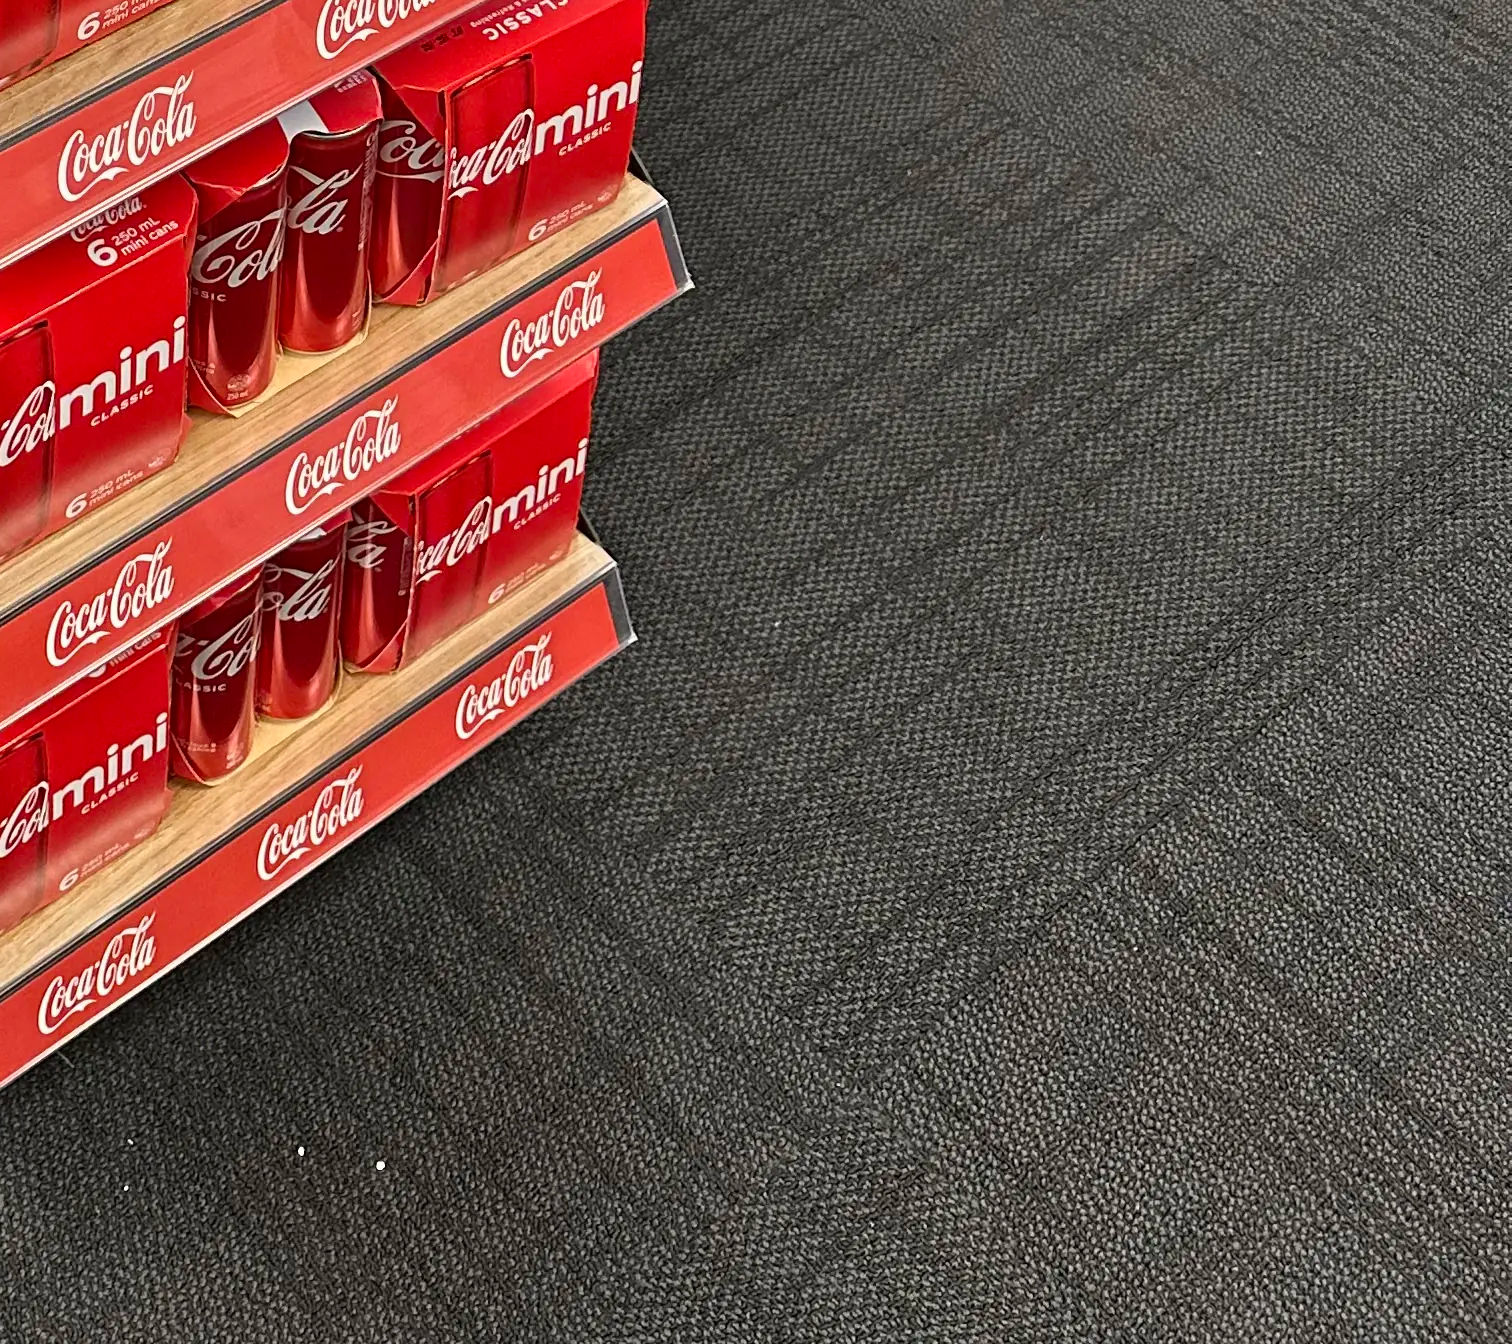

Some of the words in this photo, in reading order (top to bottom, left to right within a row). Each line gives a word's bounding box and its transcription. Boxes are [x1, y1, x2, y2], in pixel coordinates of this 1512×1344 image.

[77, 11, 101, 41] 6
[102, 7, 130, 30] mini
[534, 60, 642, 153] mini
[55, 70, 198, 203] Coca-Cola
[558, 121, 612, 157] CLASSIC
[111, 230, 138, 247] 250
[139, 216, 161, 233] mL
[121, 238, 147, 257] mini
[148, 219, 179, 242] cans
[527, 219, 548, 241] 6
[87, 240, 118, 267] 6
[499, 266, 606, 380] Coca-Cola
[59, 315, 186, 430] mini
[90, 384, 154, 427] CLASSIC
[285, 393, 402, 516] Coca-Cola
[65, 494, 87, 519] 6
[493, 438, 588, 534] mini
[513, 493, 561, 530] CLASSIC
[44, 535, 176, 668] Coca-Cola
[488, 582, 505, 603] 6
[455, 630, 554, 739] Coca-Cola
[52, 711, 168, 821] mini
[81, 774, 139, 815] CLASSIC
[256, 764, 363, 882] Coca-Cola
[58, 868, 80, 892] 6
[37, 911, 157, 1036] Coca-Cola
